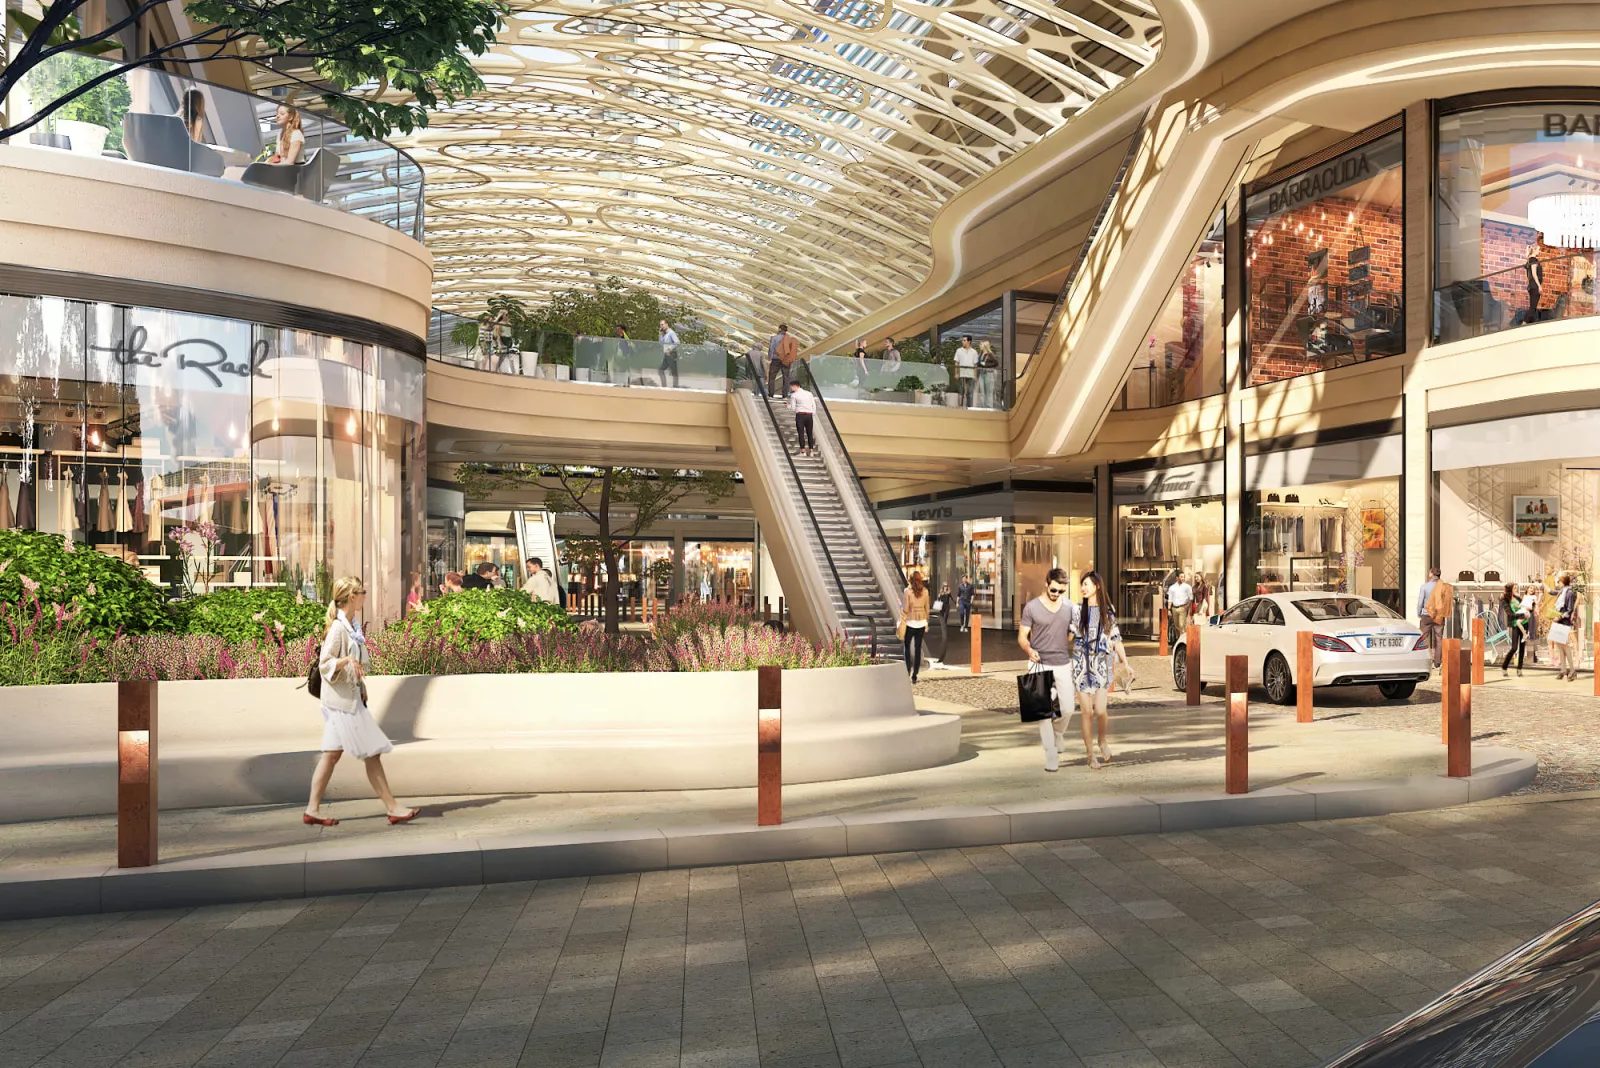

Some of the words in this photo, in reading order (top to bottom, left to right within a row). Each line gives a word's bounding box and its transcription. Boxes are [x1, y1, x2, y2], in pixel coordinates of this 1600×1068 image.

[1268, 152, 1371, 214] BARRACUDA
[90, 325, 162, 368] the
[162, 338, 273, 388] Rack
[1370, 637, 1377, 647] 34
